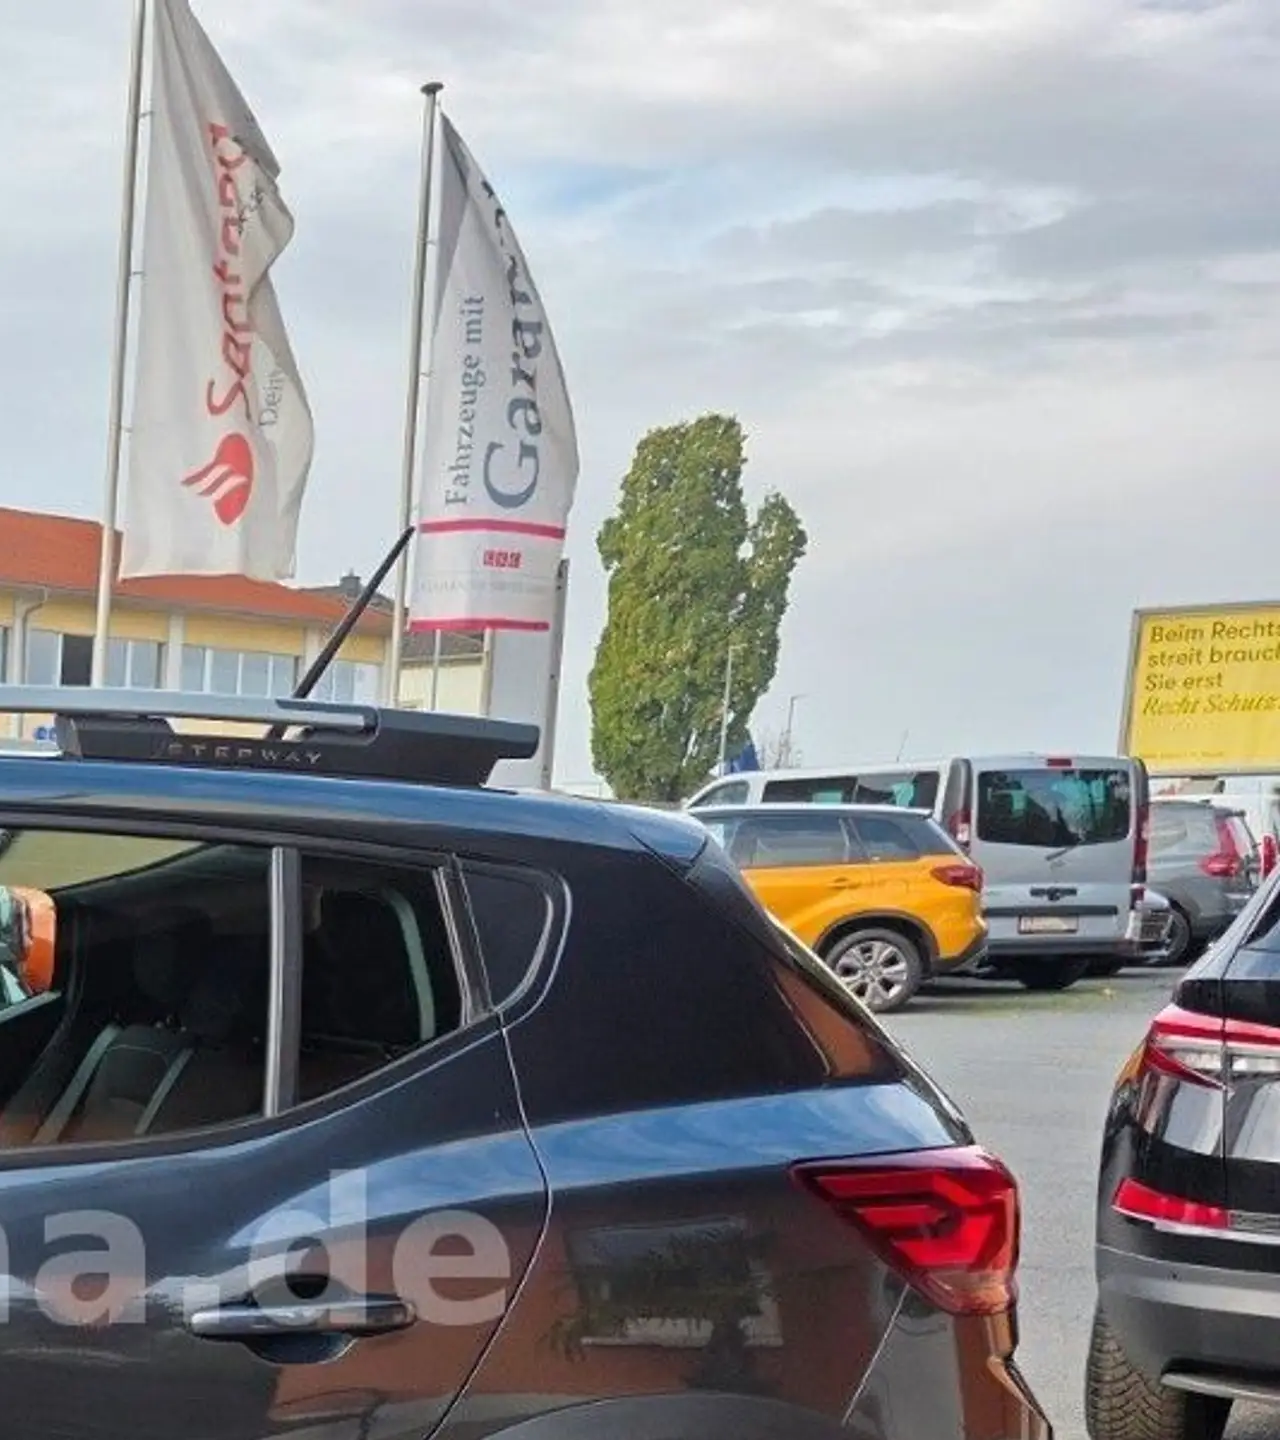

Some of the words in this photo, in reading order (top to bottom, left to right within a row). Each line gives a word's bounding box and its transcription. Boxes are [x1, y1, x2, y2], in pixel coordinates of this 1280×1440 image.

[464, 296, 484, 344] mit
[445, 353, 487, 506] Fahrzeuge
[1150, 624, 1205, 644] Beim
[1148, 647, 1203, 668] streit
[1145, 673, 1176, 692] Sie
[1183, 671, 1223, 690] erst
